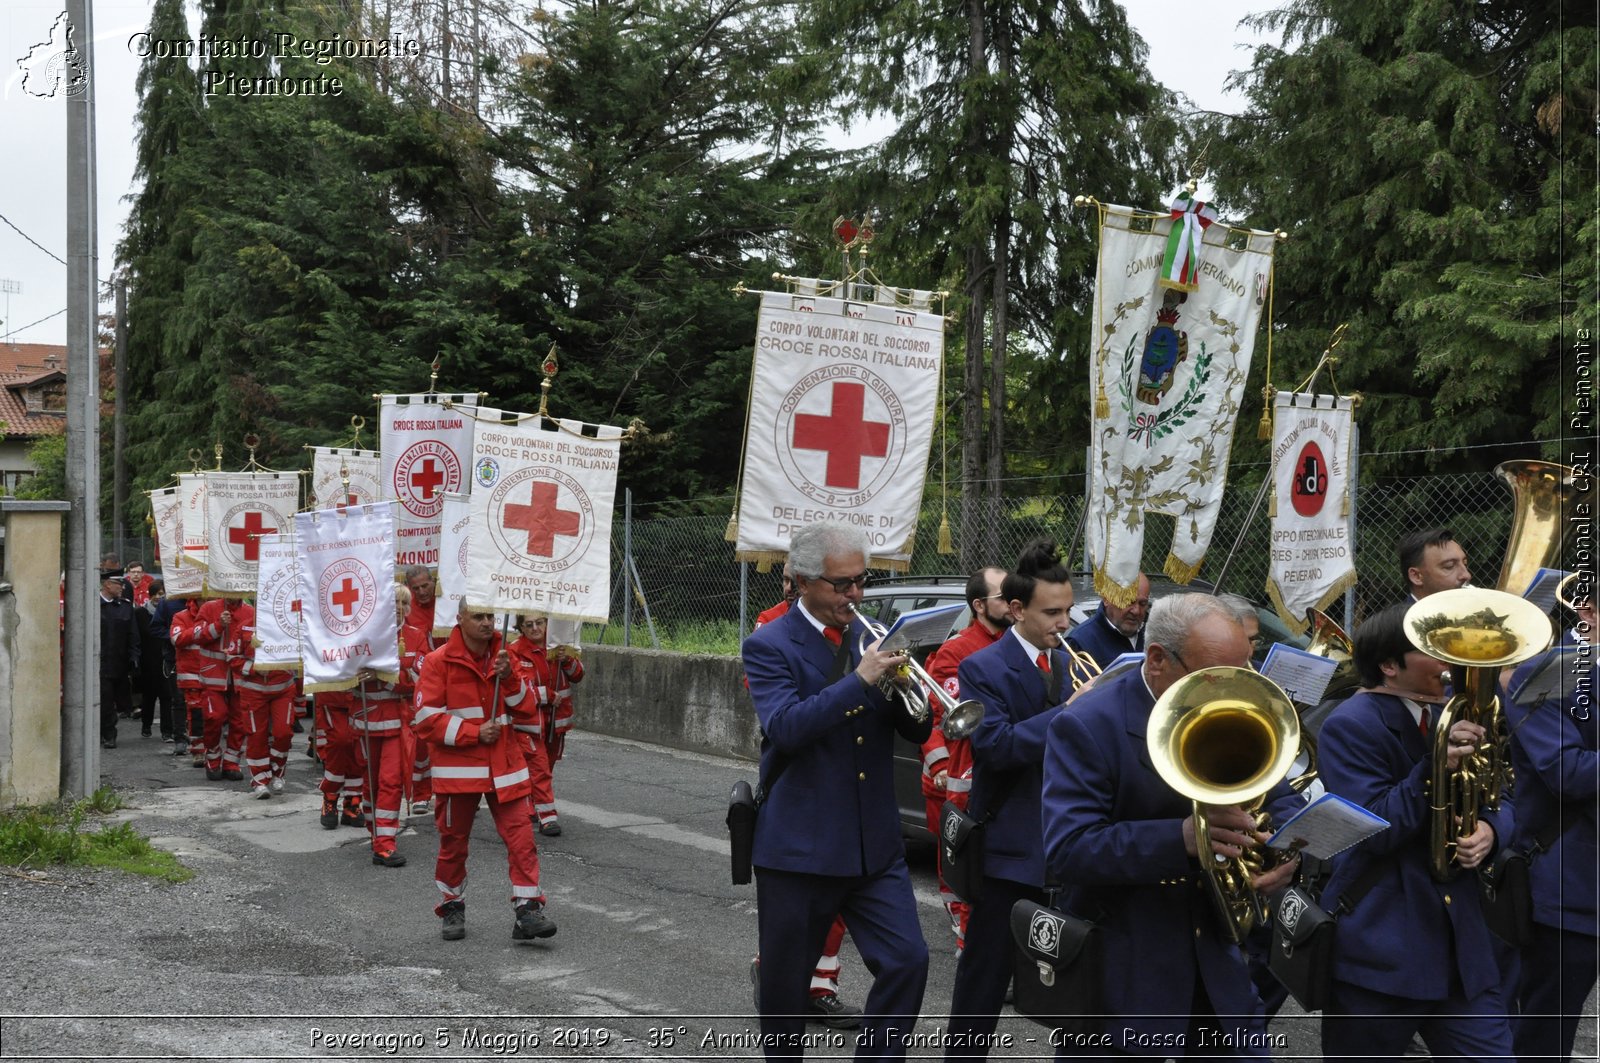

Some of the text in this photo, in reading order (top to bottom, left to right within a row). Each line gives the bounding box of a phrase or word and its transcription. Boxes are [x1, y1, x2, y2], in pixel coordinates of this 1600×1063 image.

[1126, 254, 1246, 297] COMUN VERAGNO
[770, 320, 930, 353] CORPO VOLONTARI DEL SOCCORSO
[760, 336, 937, 371] CROCE ROSSA ITALIANA
[782, 366, 905, 426] CONVENZIONE DI GINEVRA
[393, 419, 463, 431] CROCE ROSSA ITALIANA
[482, 432, 613, 459] CORPO VOLONTARI DEL SOCCORSO
[397, 443, 433, 488] CONVENZIONE
[442, 450, 458, 485] GINEVRA
[476, 444, 616, 471] CROCE ROSSA ITALIANA
[208, 491, 235, 499] CROCE
[493, 468, 550, 503] CONVENZIONE
[554, 471, 564, 480] DI
[565, 477, 591, 514] GINEVRA
[413, 505, 435, 515] AGOSTO
[397, 526, 442, 537] COMITATO LOC
[879, 516, 894, 528] DI
[425, 537, 432, 547] di
[396, 548, 438, 565] MONDO
[1320, 546, 1346, 560] PESIO
[261, 569, 286, 601] CROCE
[491, 573, 541, 586] COMITATO
[551, 580, 591, 594] LOCALE
[499, 585, 578, 606] MORETTA
[264, 644, 292, 654] GRUPPO
[322, 643, 373, 663] MANTA
